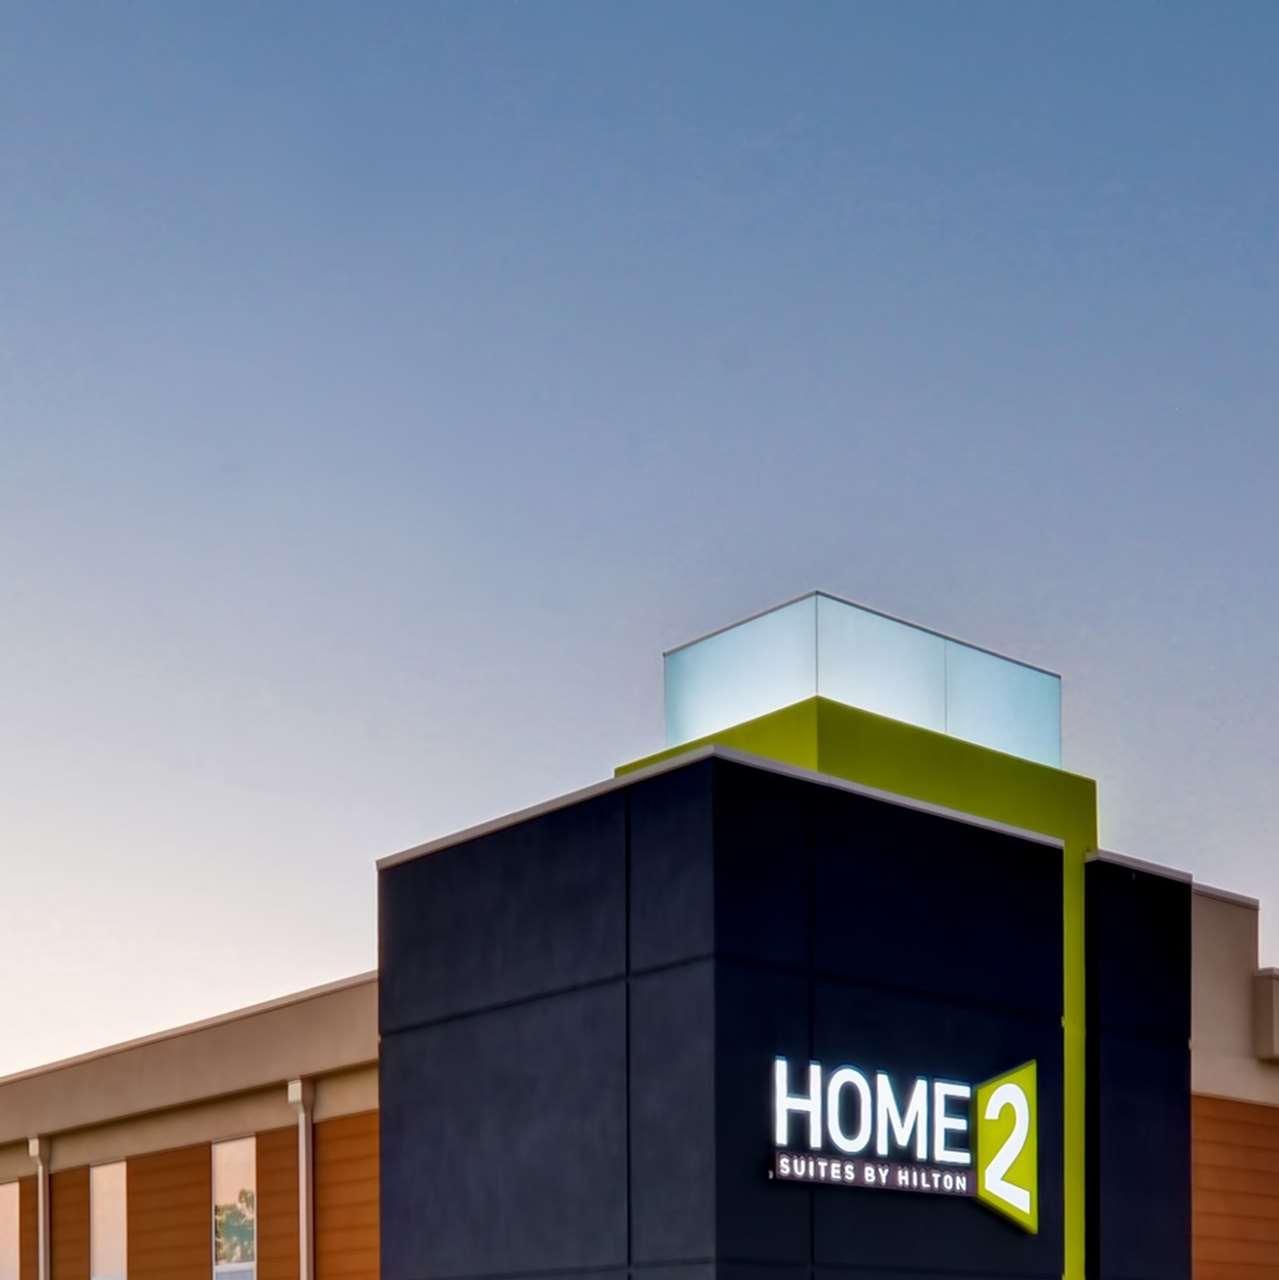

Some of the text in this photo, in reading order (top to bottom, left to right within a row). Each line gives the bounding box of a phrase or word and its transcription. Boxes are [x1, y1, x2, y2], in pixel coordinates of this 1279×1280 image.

[779, 1157, 967, 1191] SUITES BY HILTON
